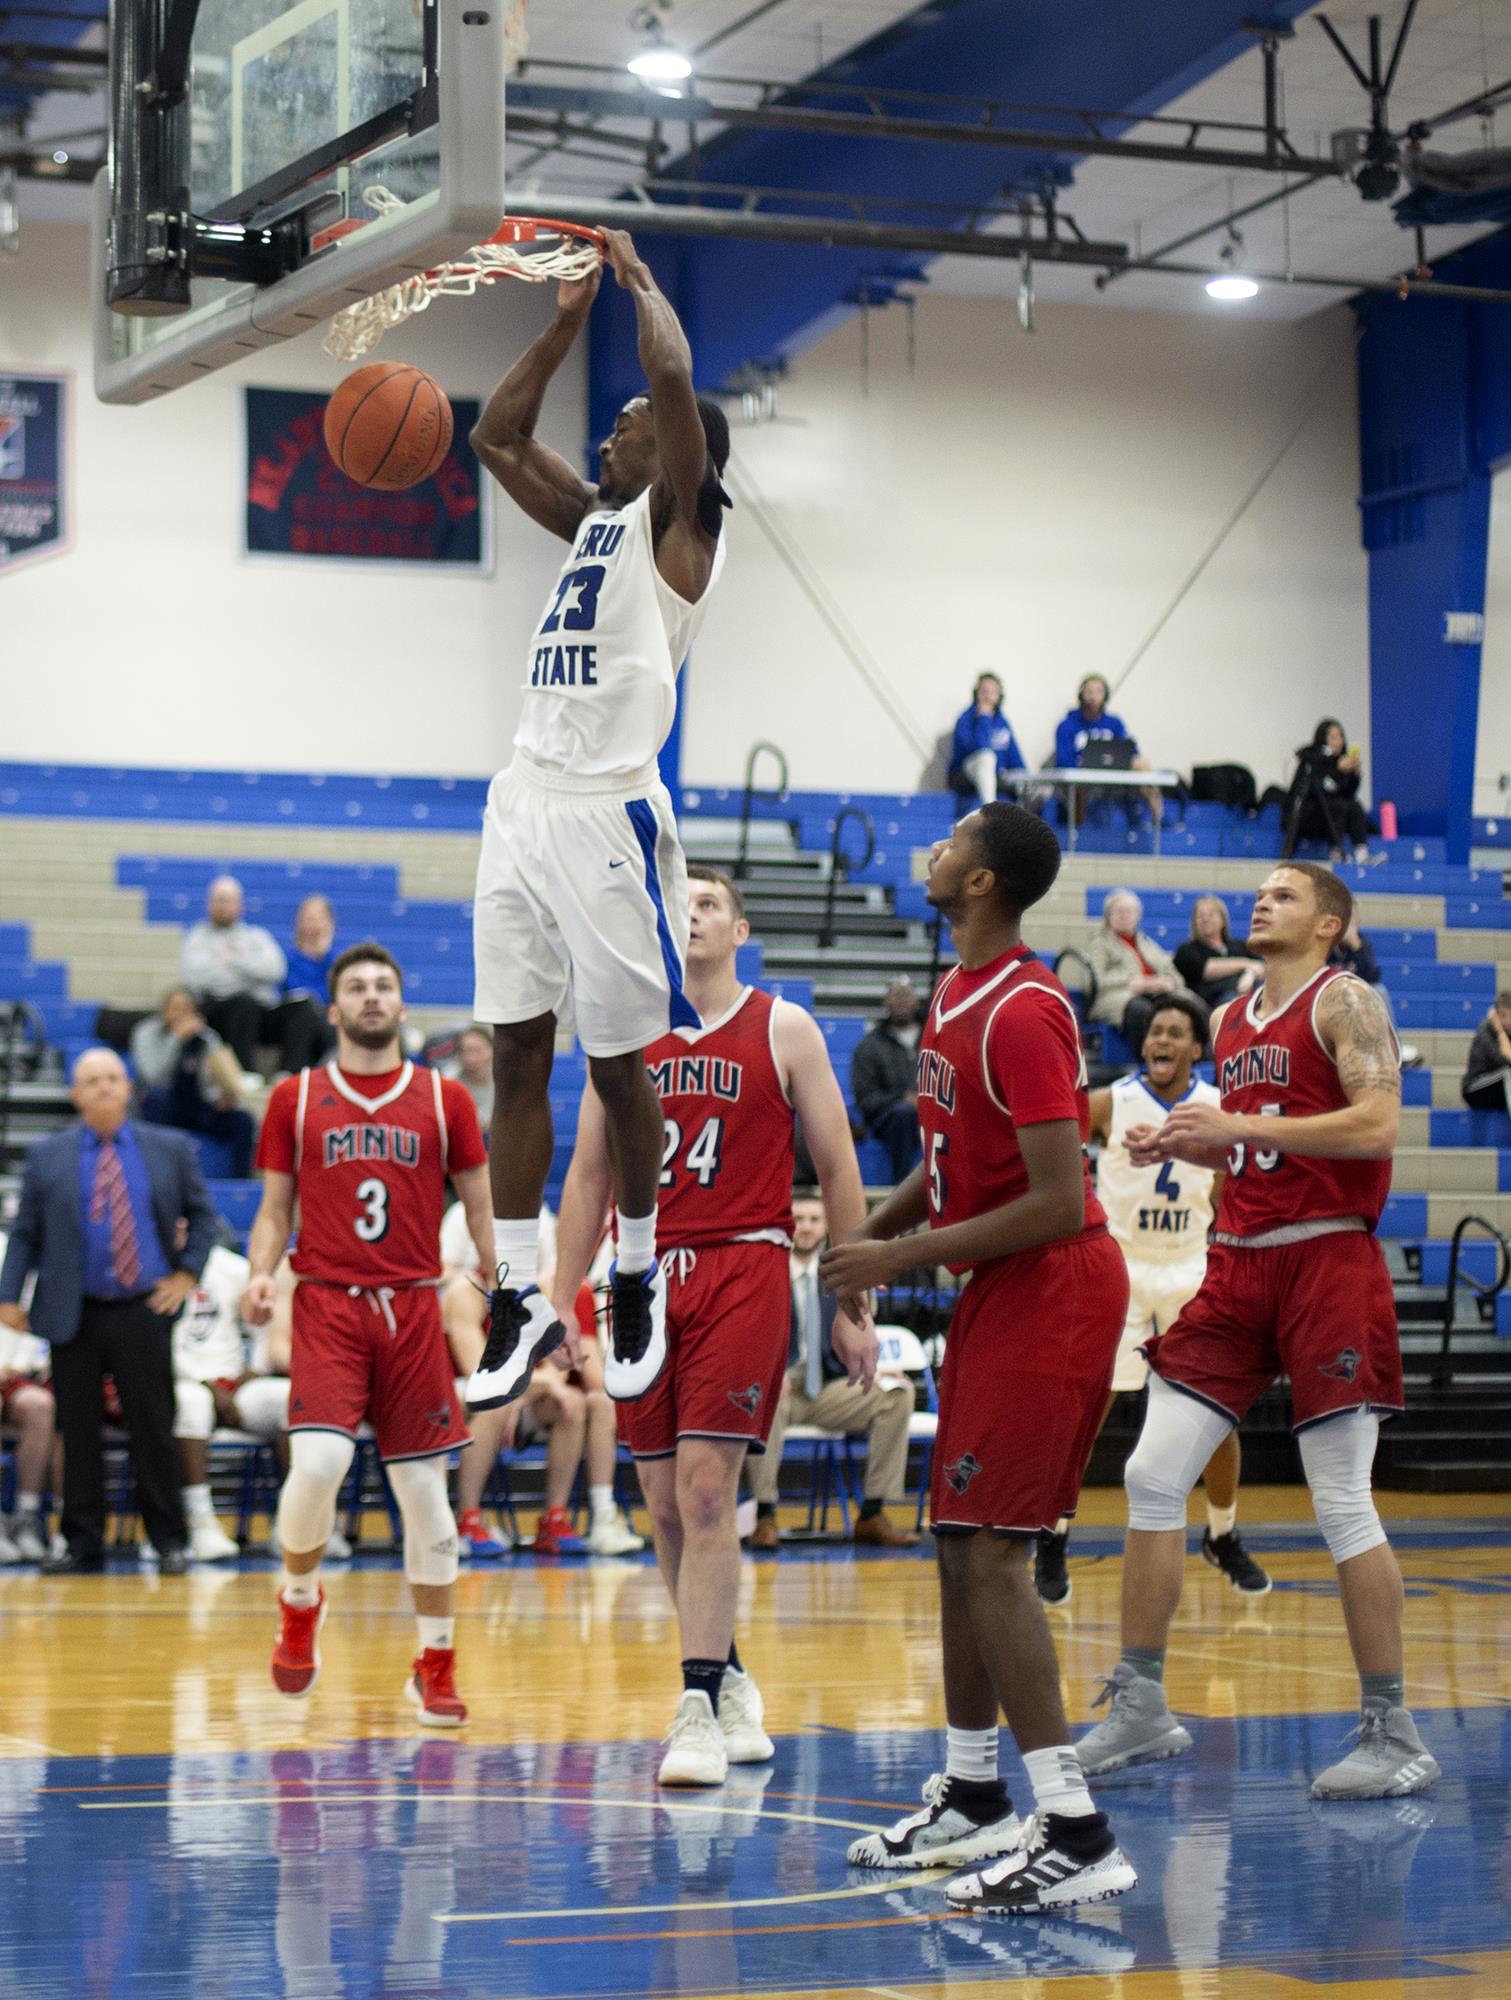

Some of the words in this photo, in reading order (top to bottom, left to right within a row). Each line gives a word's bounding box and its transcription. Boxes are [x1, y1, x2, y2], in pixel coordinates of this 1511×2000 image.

[539, 564, 606, 635] 23
[531, 645, 598, 686] STATE
[645, 1055, 743, 1103] MNU
[1220, 1044, 1290, 1099] MNU
[322, 1122, 421, 1169] MNU
[659, 1116, 724, 1189] 24
[353, 1178, 391, 1244] 3
